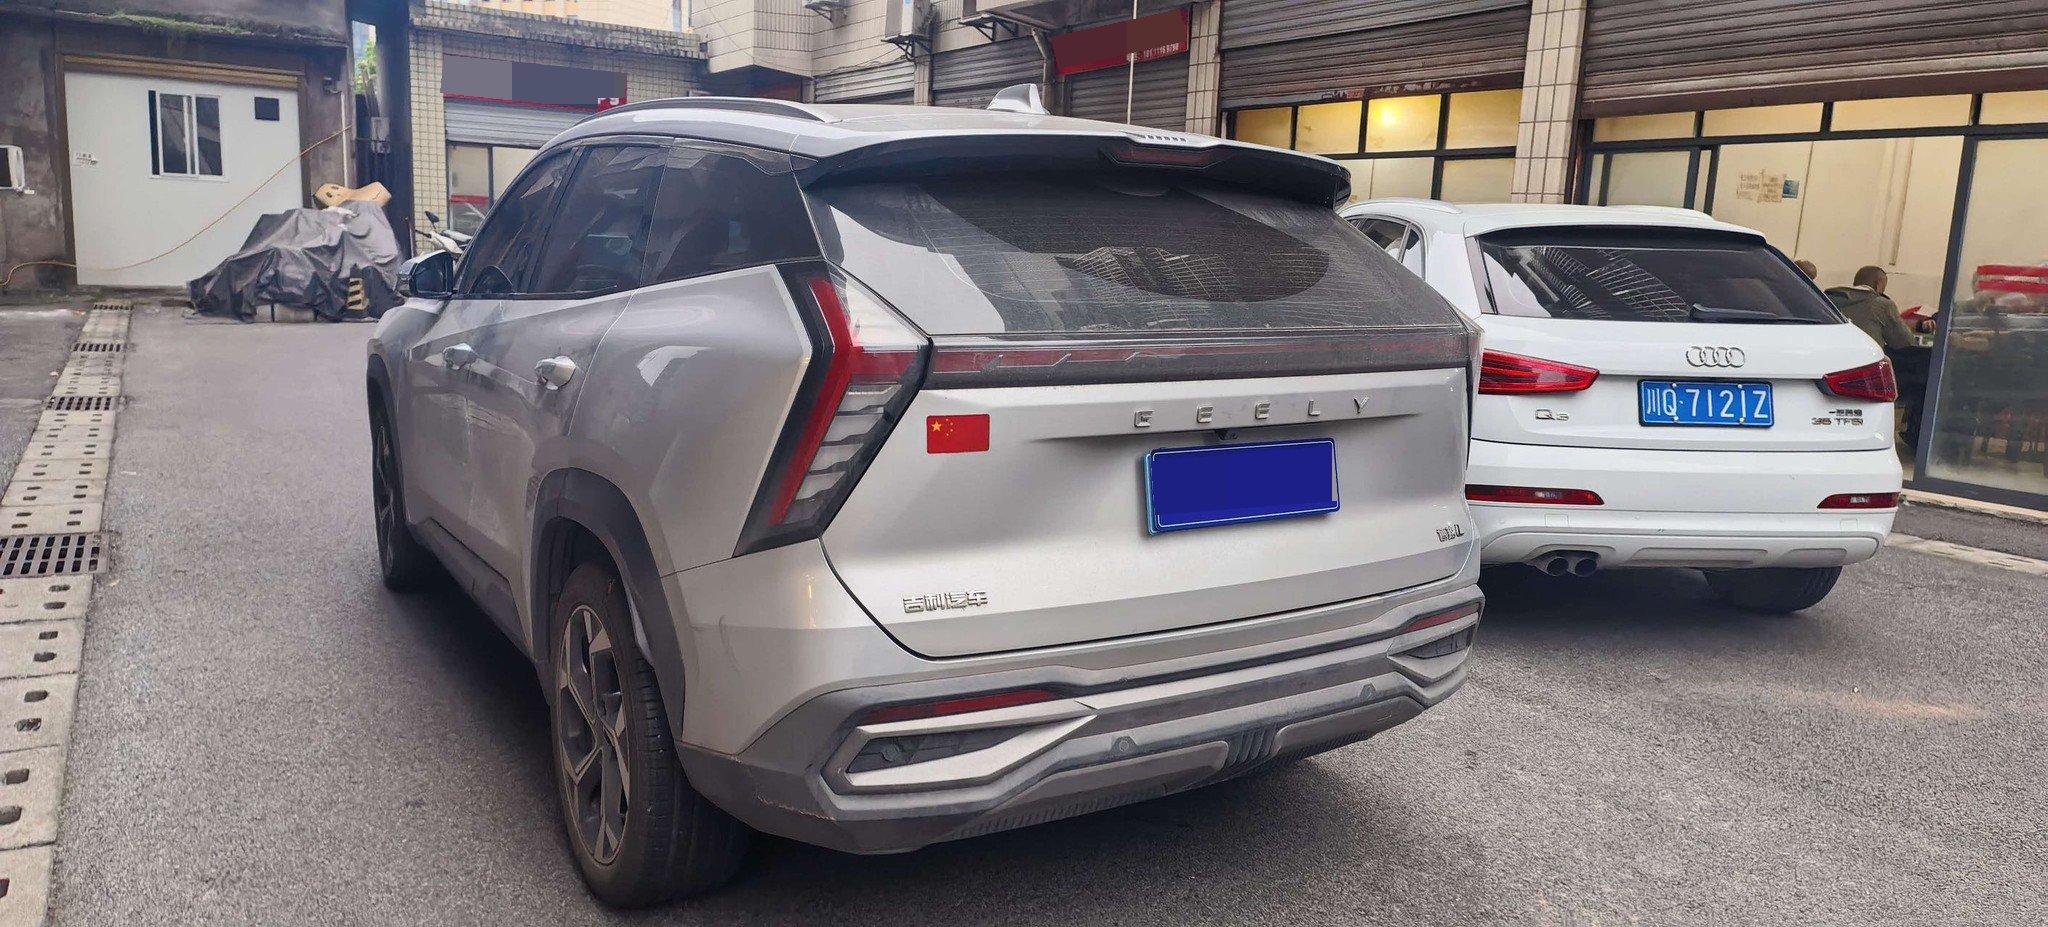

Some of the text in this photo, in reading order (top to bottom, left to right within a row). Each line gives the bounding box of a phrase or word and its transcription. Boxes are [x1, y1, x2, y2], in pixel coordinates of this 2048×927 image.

[1134, 396, 1369, 428] GEELY
[1534, 408, 1570, 422] Q3
[902, 590, 989, 614] 吉利汽车
